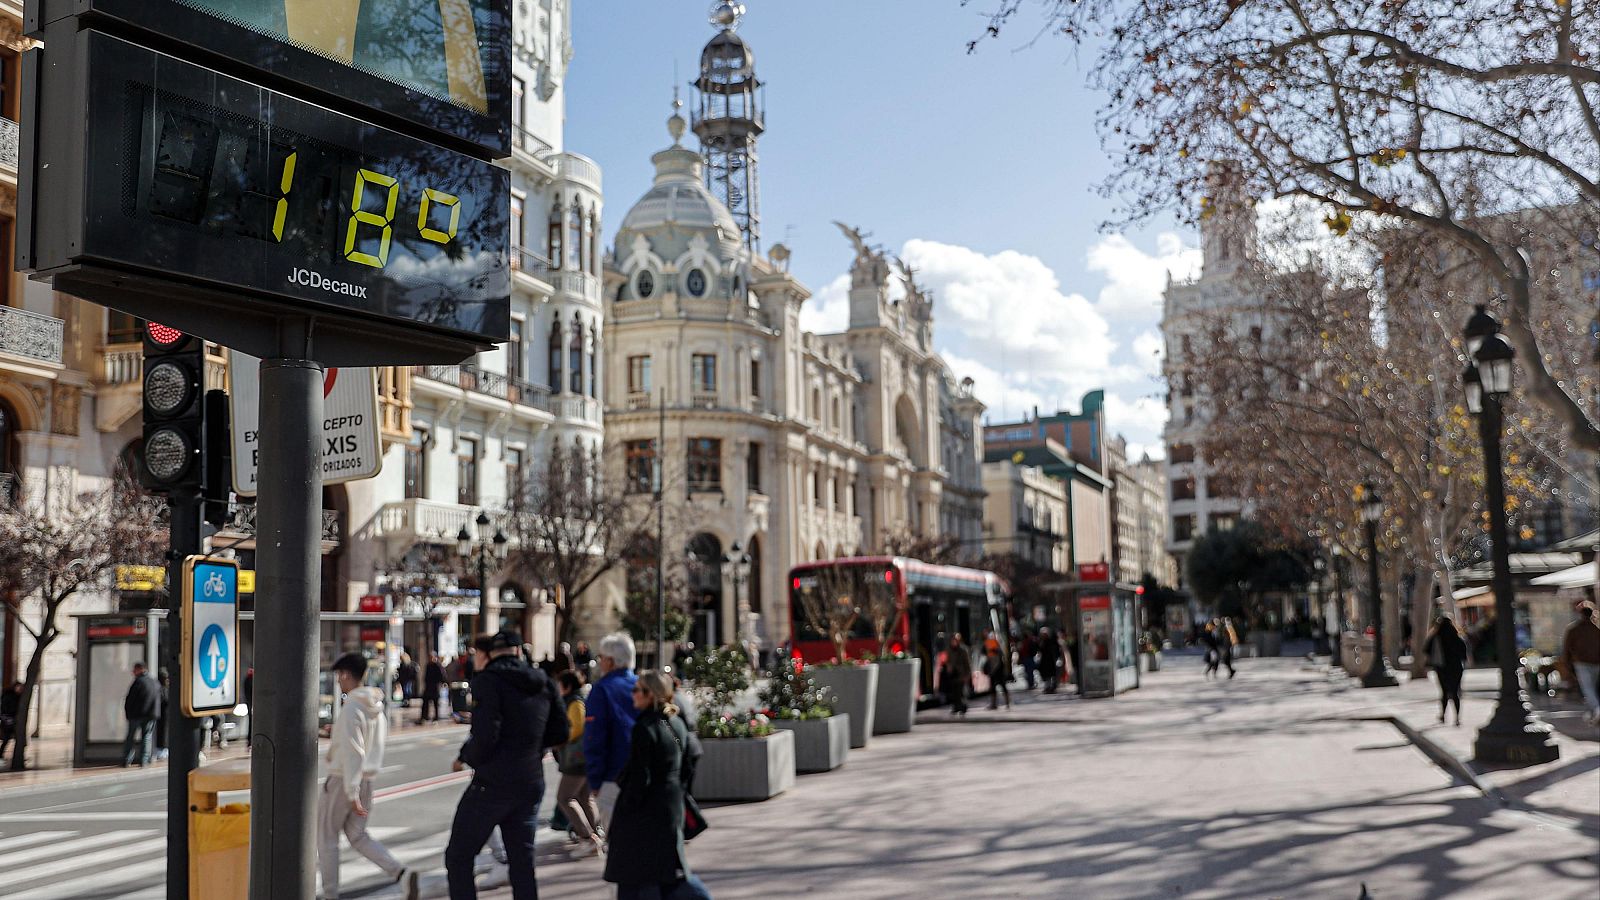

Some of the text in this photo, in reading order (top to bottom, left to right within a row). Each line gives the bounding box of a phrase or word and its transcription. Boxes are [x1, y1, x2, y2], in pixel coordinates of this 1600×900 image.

[288, 267, 367, 298] JCDecaux
[323, 414, 363, 431] CEPTO
[323, 435, 358, 456] XIS
[323, 457, 362, 473] ORIZADOS
